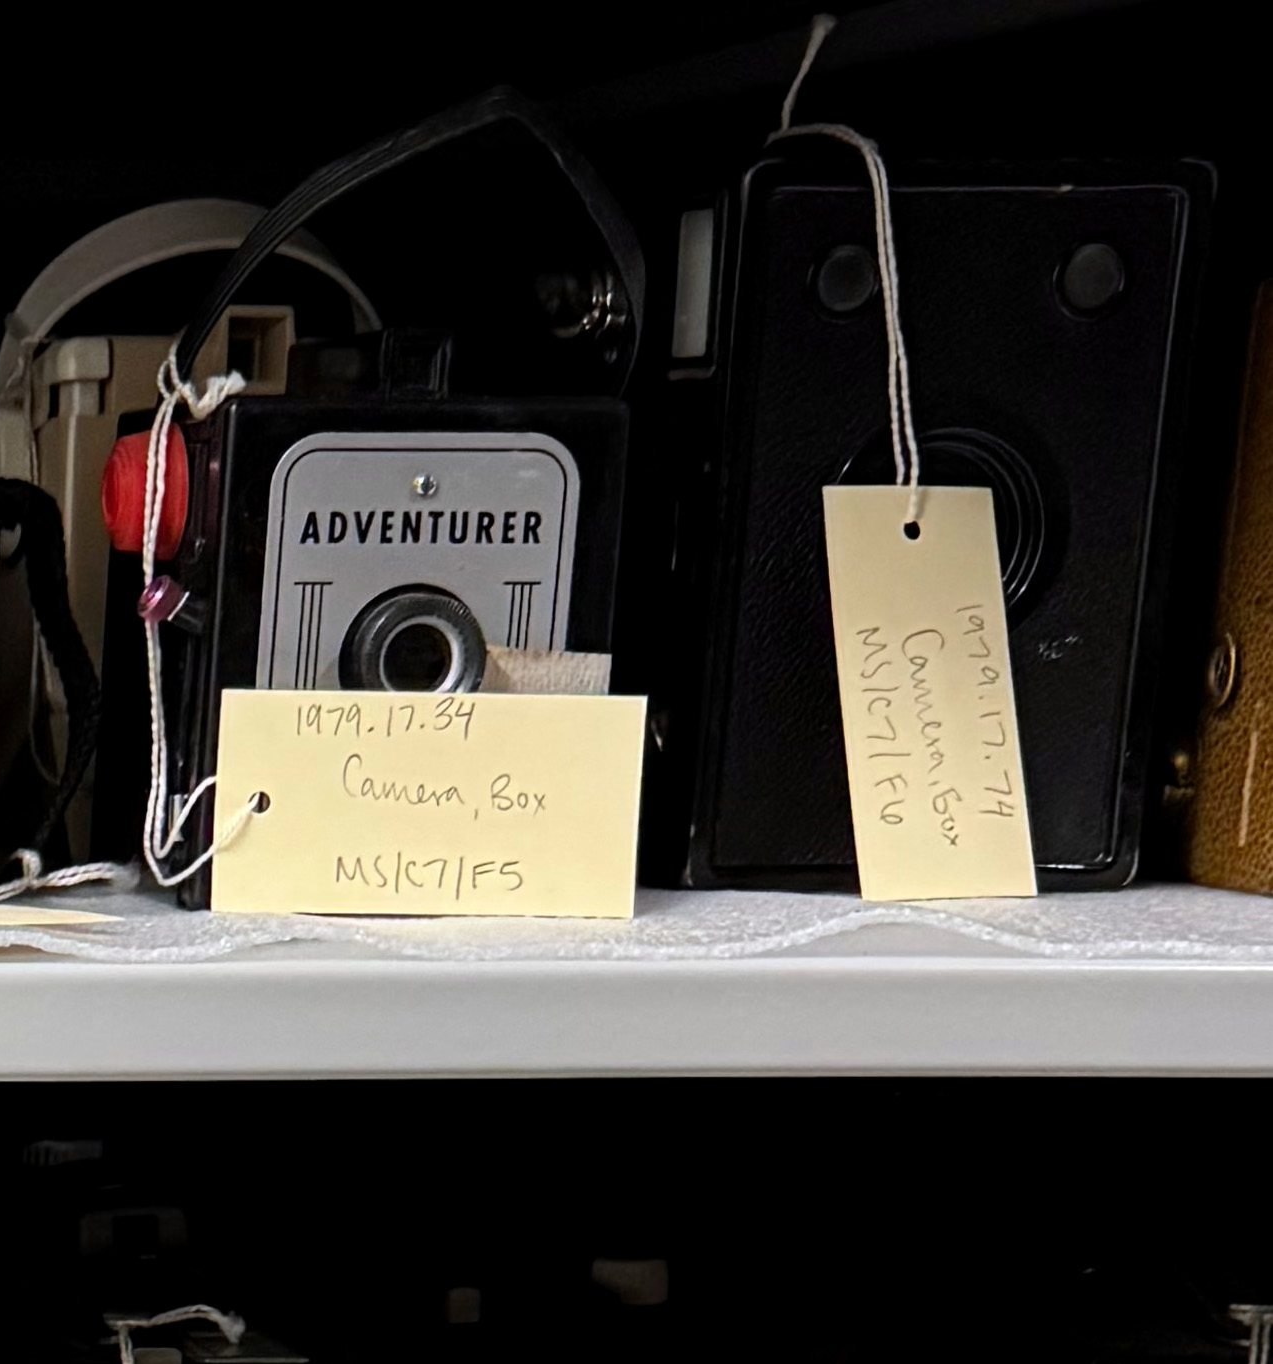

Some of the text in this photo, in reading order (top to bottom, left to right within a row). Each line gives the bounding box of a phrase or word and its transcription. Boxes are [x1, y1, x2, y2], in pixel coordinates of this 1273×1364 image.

[300, 511, 542, 545] ADVENTURER
[296, 701, 476, 741] 1979.17.34
[856, 627, 911, 825] MS/C7/F6
[956, 604, 1014, 817] 1979.17.74
[491, 775, 546, 813] Box
[335, 852, 523, 900] MS/C7/F5
